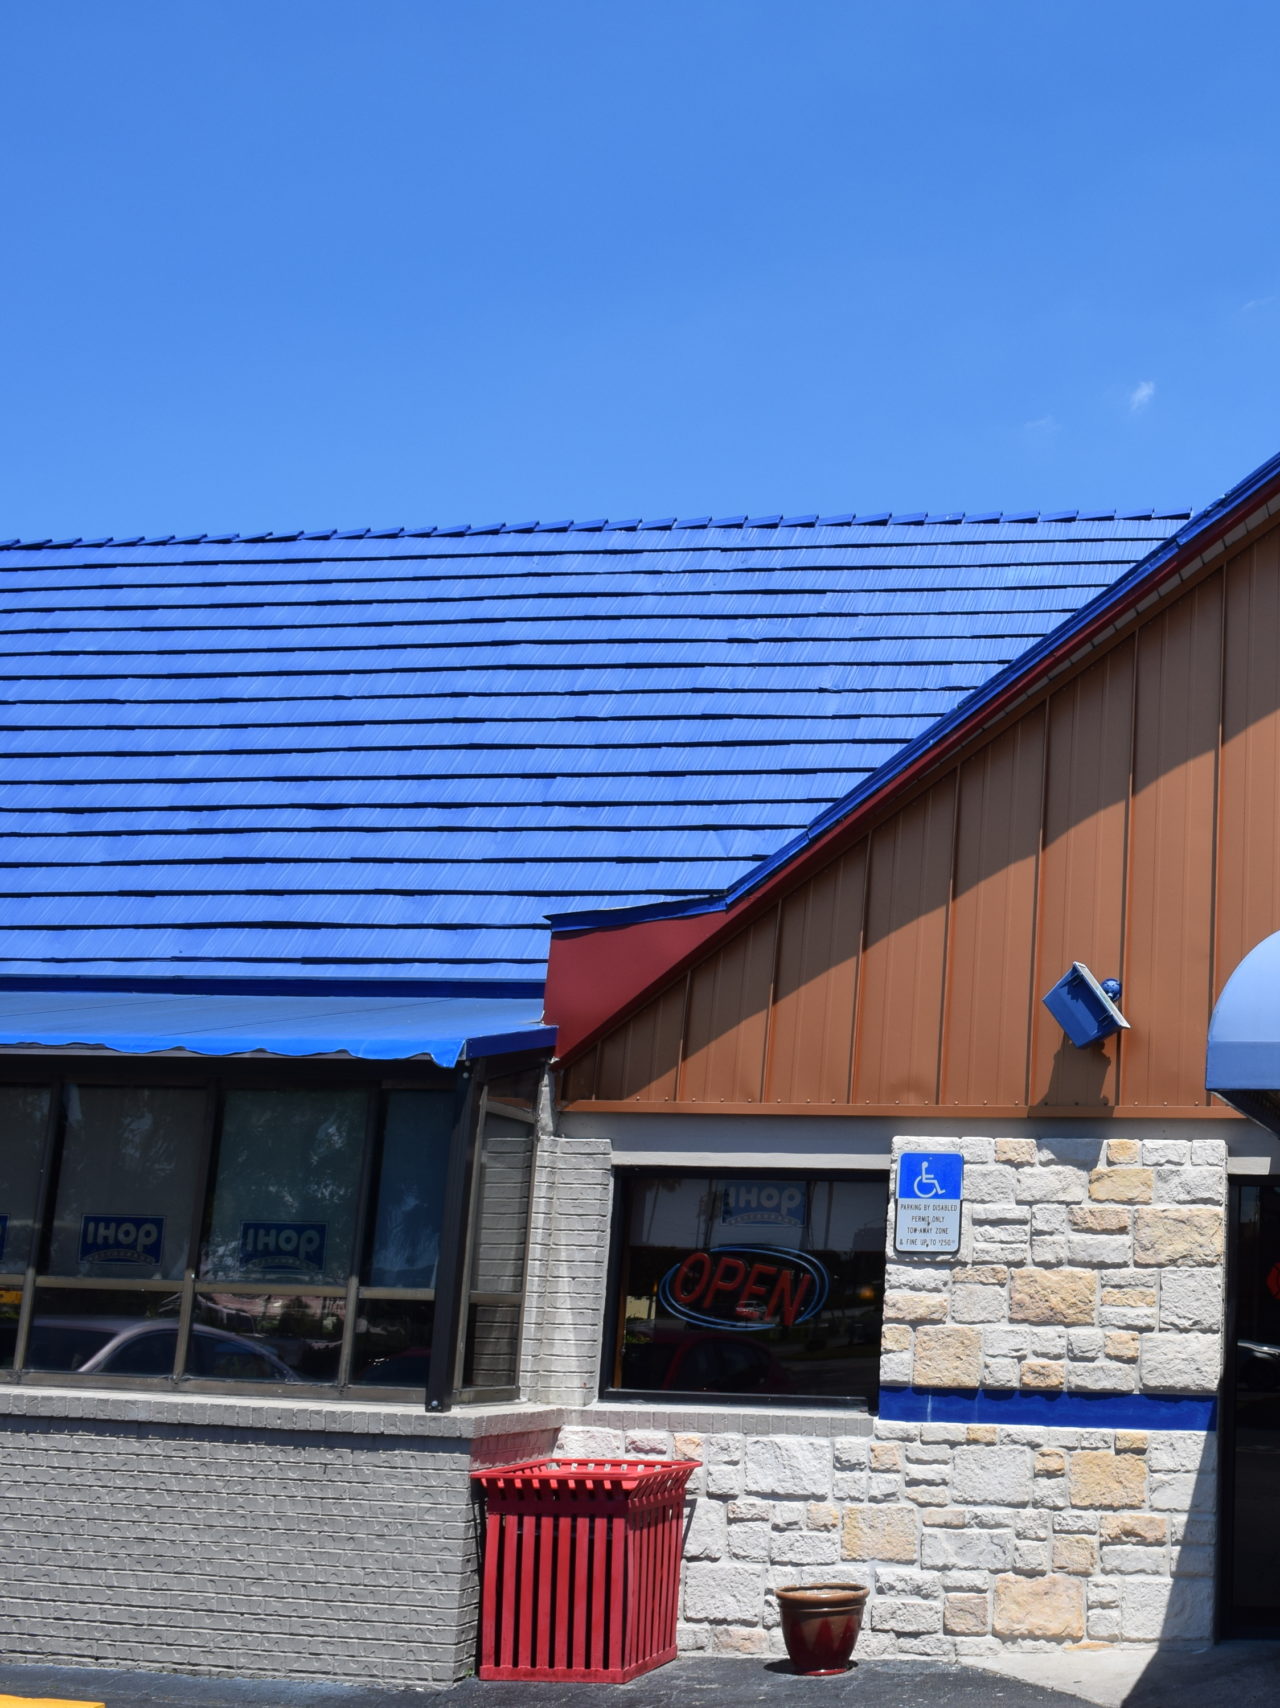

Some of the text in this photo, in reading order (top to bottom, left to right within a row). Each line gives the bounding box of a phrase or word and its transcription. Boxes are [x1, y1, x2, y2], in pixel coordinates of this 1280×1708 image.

[728, 1186, 802, 1216] IHOP
[900, 1203, 922, 1211] PARKING
[932, 1204, 958, 1212] DISABLED
[911, 1215, 945, 1223] PERMIT ONLY
[86, 1220, 159, 1252] IHOP
[935, 1227, 949, 1235] ZONE
[245, 1227, 321, 1260] IHOP
[906, 1238, 918, 1246] FINE
[919, 1238, 928, 1246] UP
[930, 1238, 937, 1246] TO
[672, 1251, 812, 1327] OPEN
